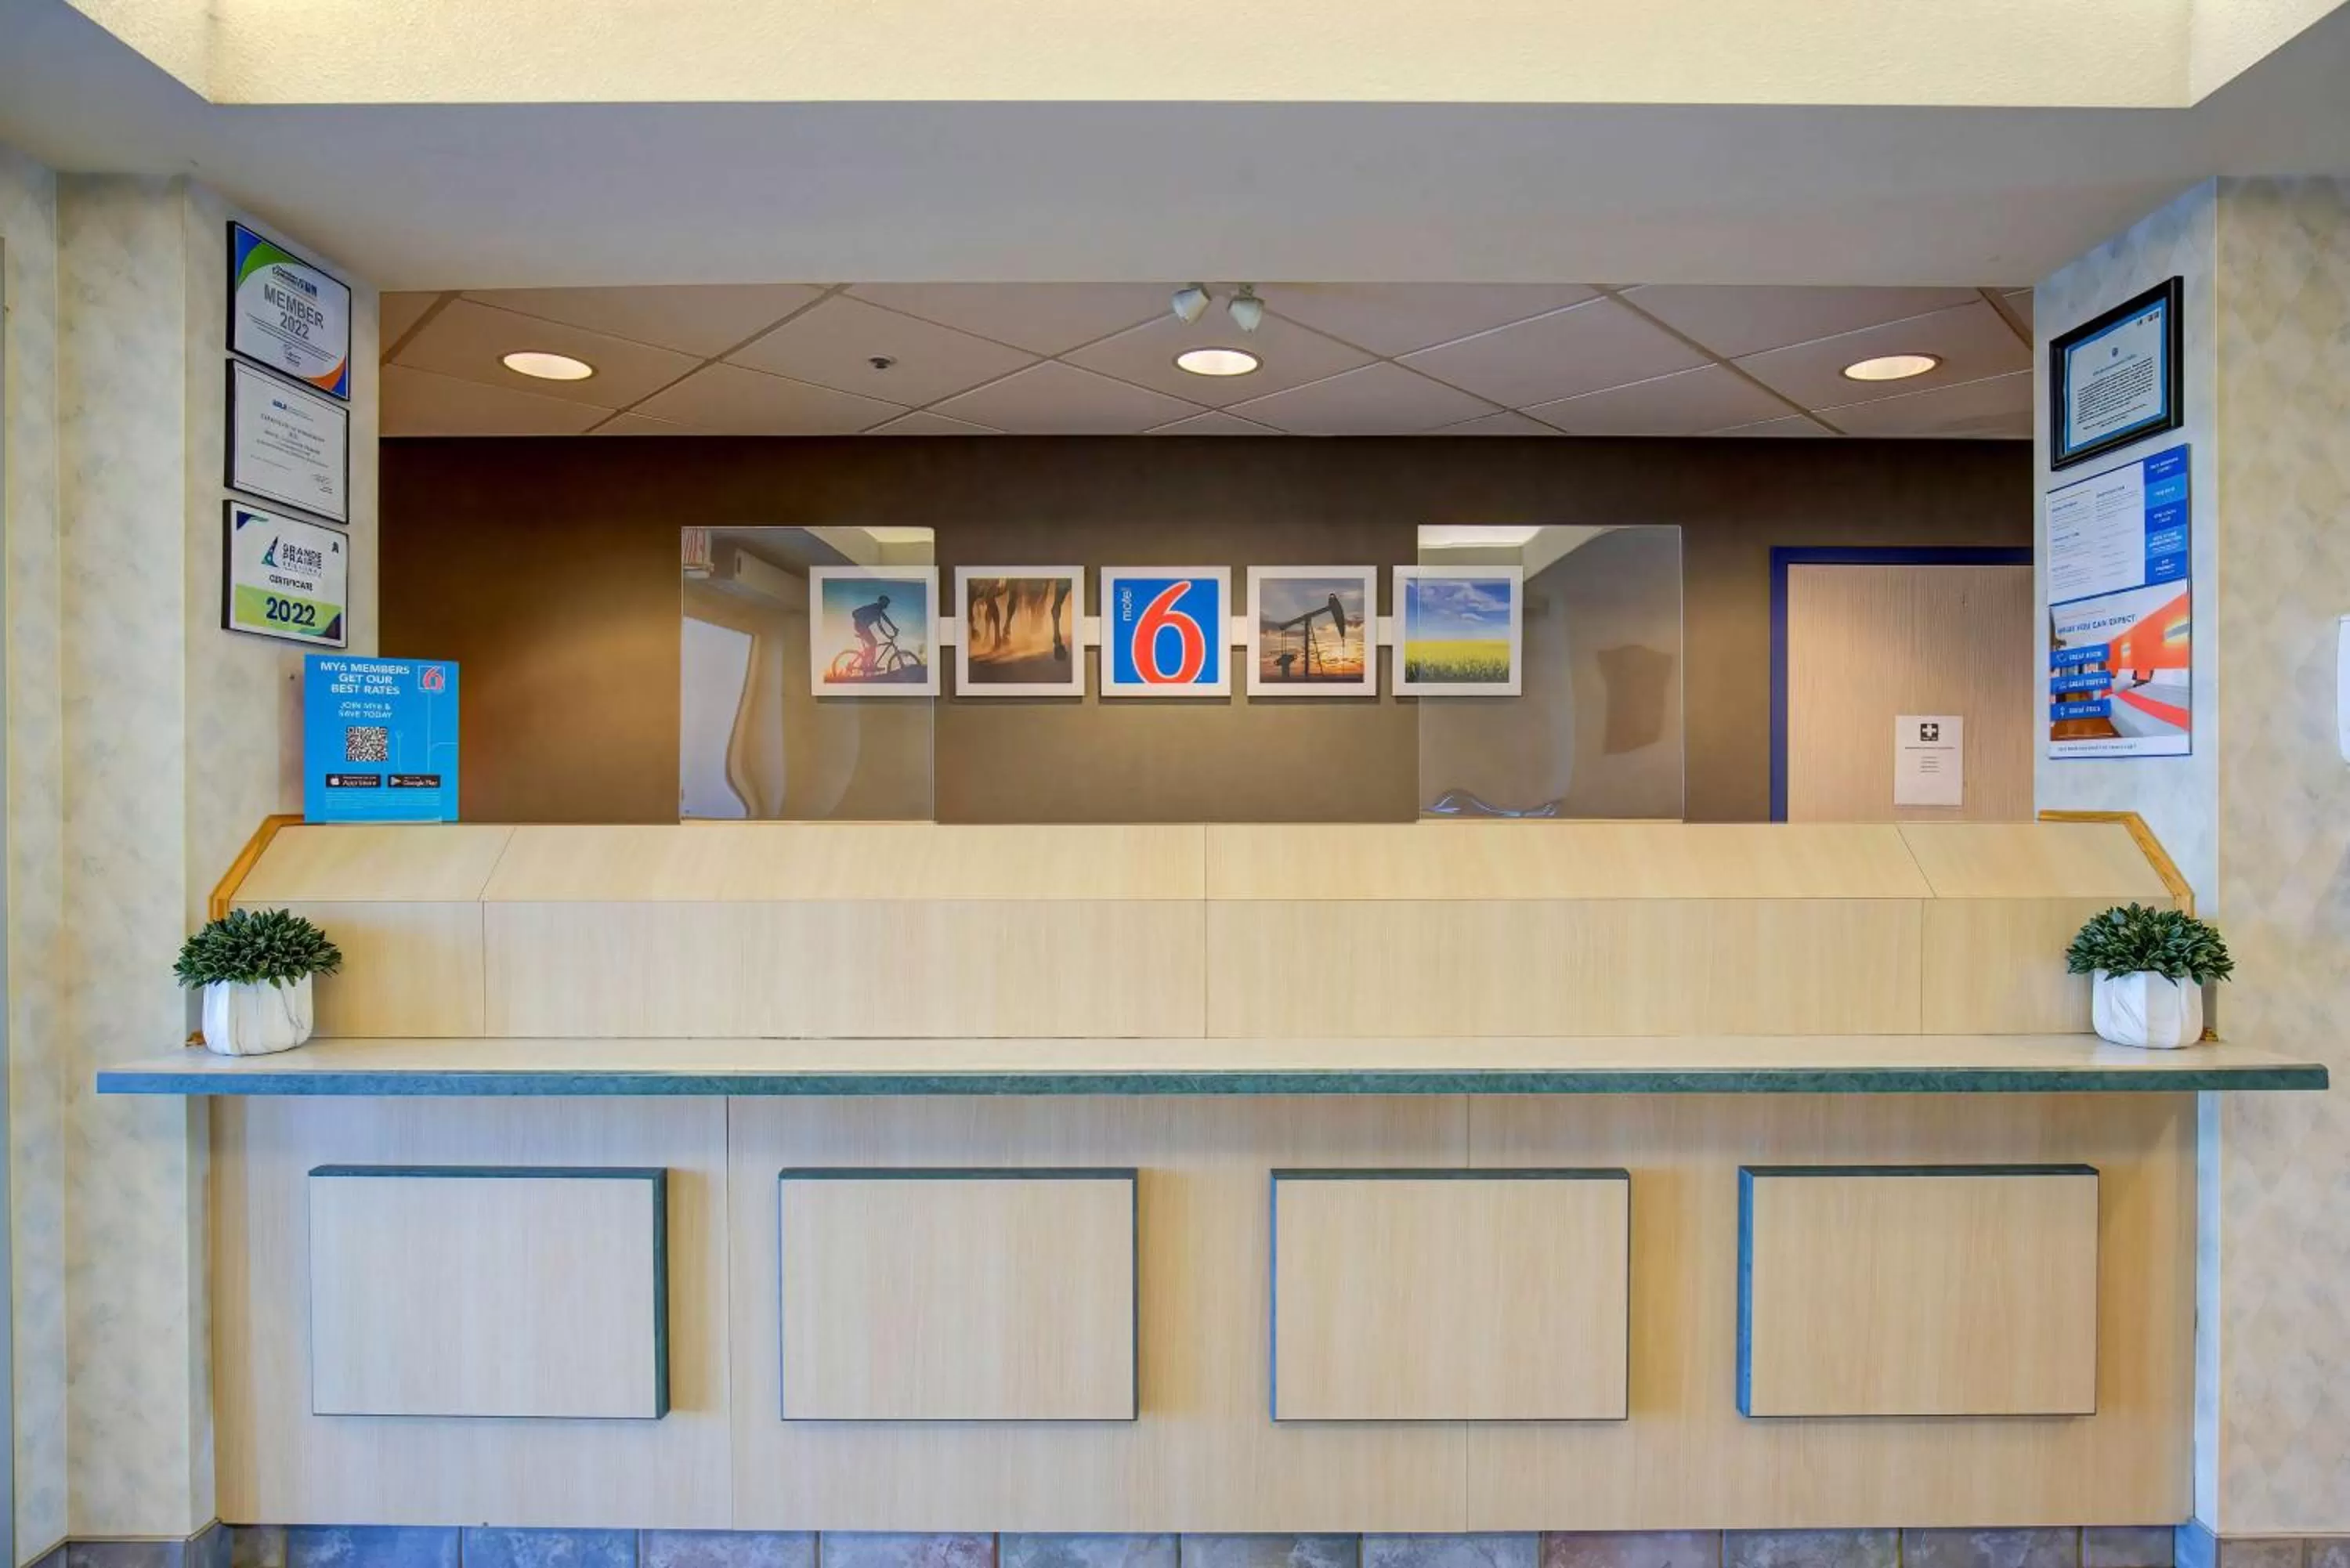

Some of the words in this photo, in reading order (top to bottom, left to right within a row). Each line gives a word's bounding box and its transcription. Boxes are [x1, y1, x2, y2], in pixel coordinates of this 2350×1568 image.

[264, 283, 324, 329] MEMBER
[280, 312, 309, 340] 2022
[283, 543, 322, 560] GRANDE
[269, 574, 313, 592] CERTIFICATE
[266, 596, 316, 627] 2022
[2092, 620, 2106, 629] CAN
[1131, 580, 1206, 685] 6
[320, 661, 347, 671] MY6
[350, 663, 410, 675] MEMBERS
[338, 673, 363, 683] GET
[366, 674, 392, 684] OUR
[331, 684, 360, 694] BEST
[363, 685, 400, 695] RATES
[340, 701, 360, 710] JOIN
[363, 710, 393, 720] TODAY
